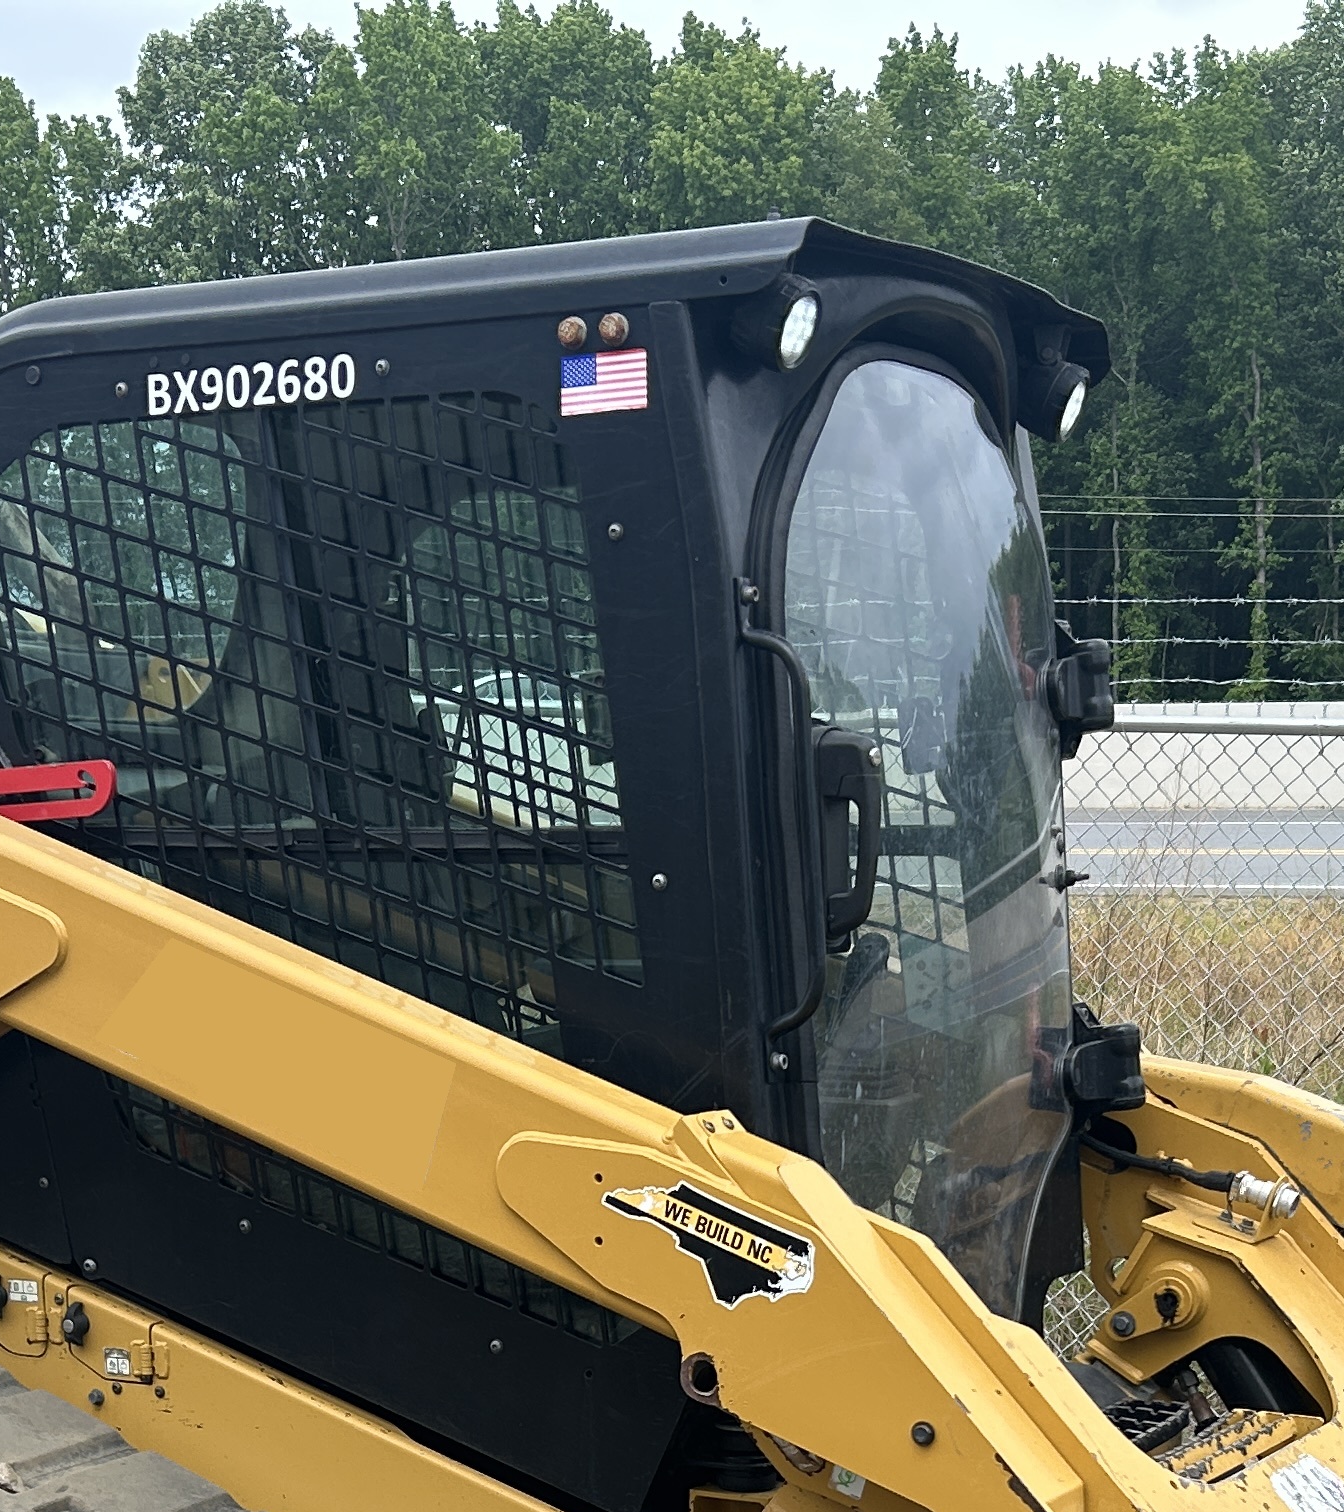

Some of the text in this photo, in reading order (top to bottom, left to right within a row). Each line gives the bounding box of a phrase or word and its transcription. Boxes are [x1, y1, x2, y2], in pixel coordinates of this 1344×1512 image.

[147, 353, 355, 416] BX902680
[664, 1199, 773, 1264] WE BUILD NC
